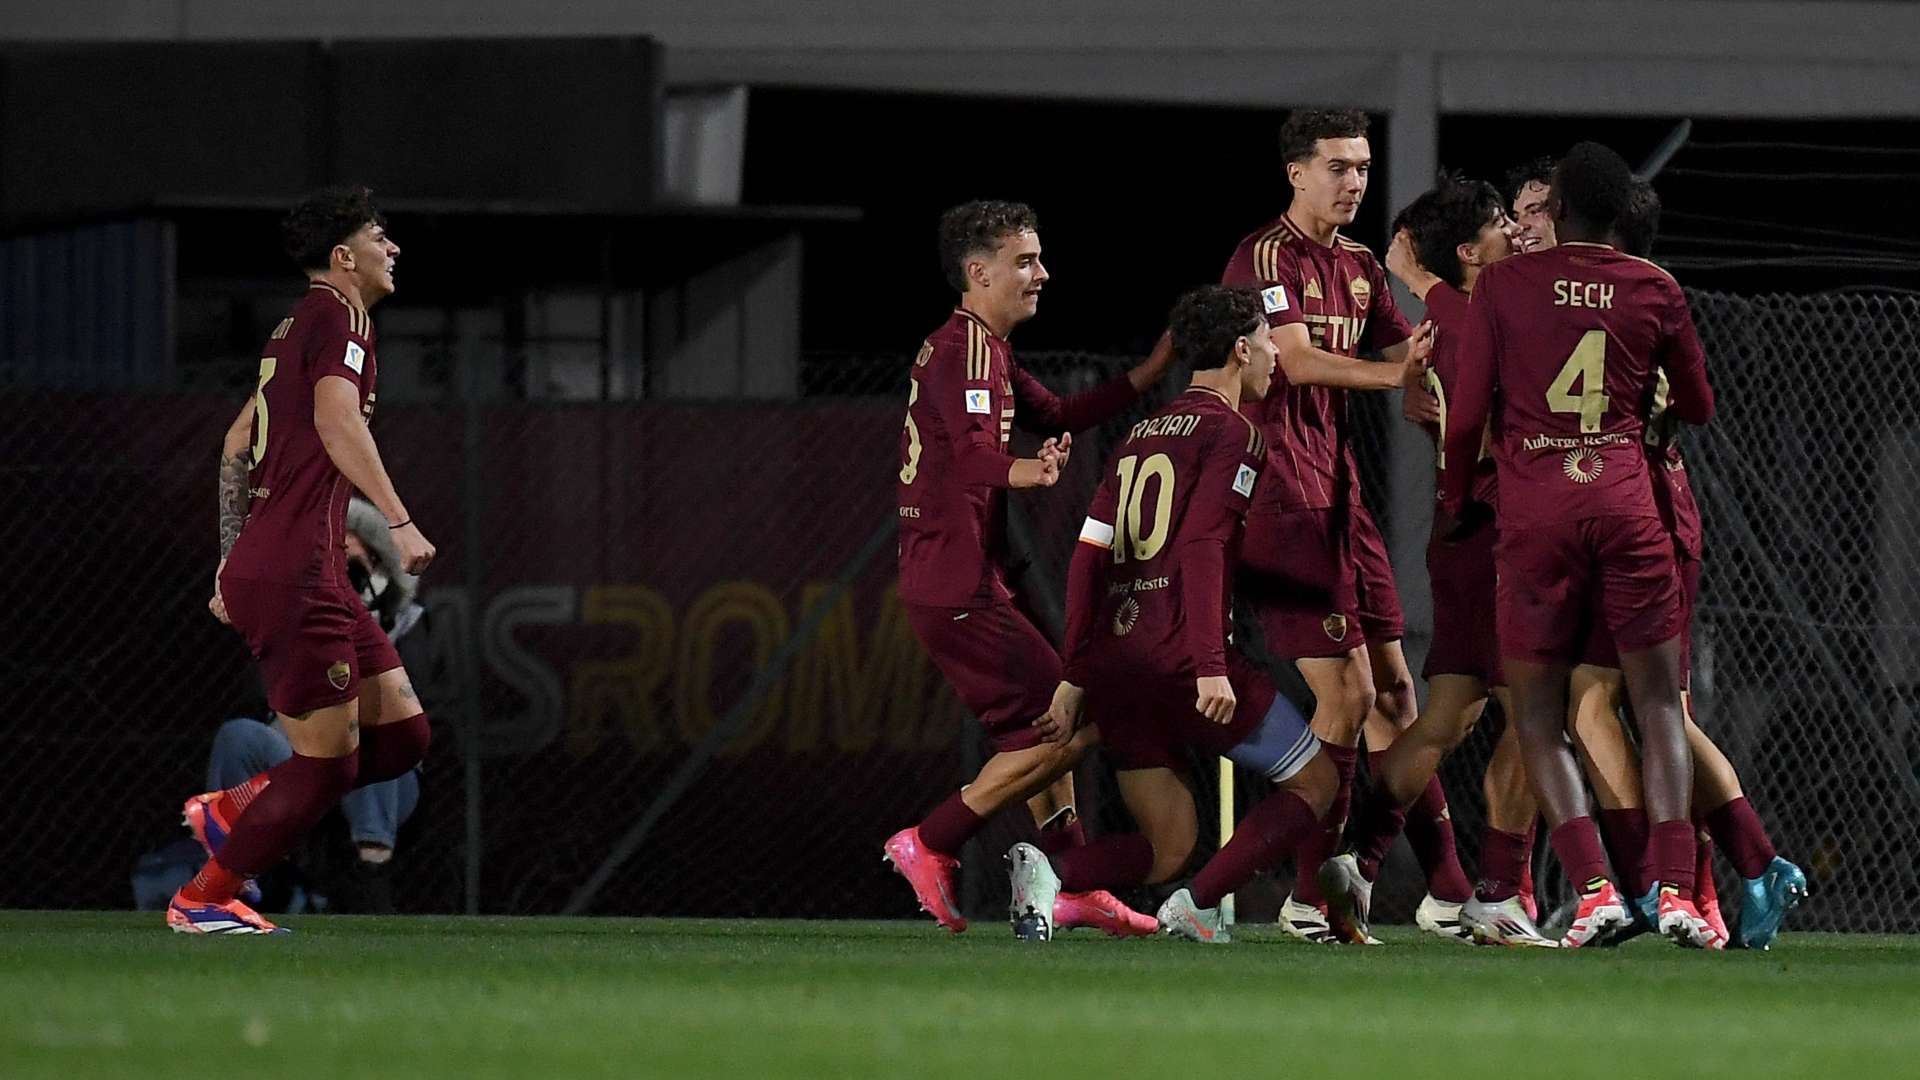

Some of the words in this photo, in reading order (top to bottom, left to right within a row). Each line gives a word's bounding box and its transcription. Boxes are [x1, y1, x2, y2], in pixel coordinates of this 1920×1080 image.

[1553, 279, 1615, 310] SECK
[1545, 329, 1610, 434] 4
[1522, 433, 1580, 451] Auberge
[899, 505, 921, 519] orts
[1113, 452, 1176, 565] 10
